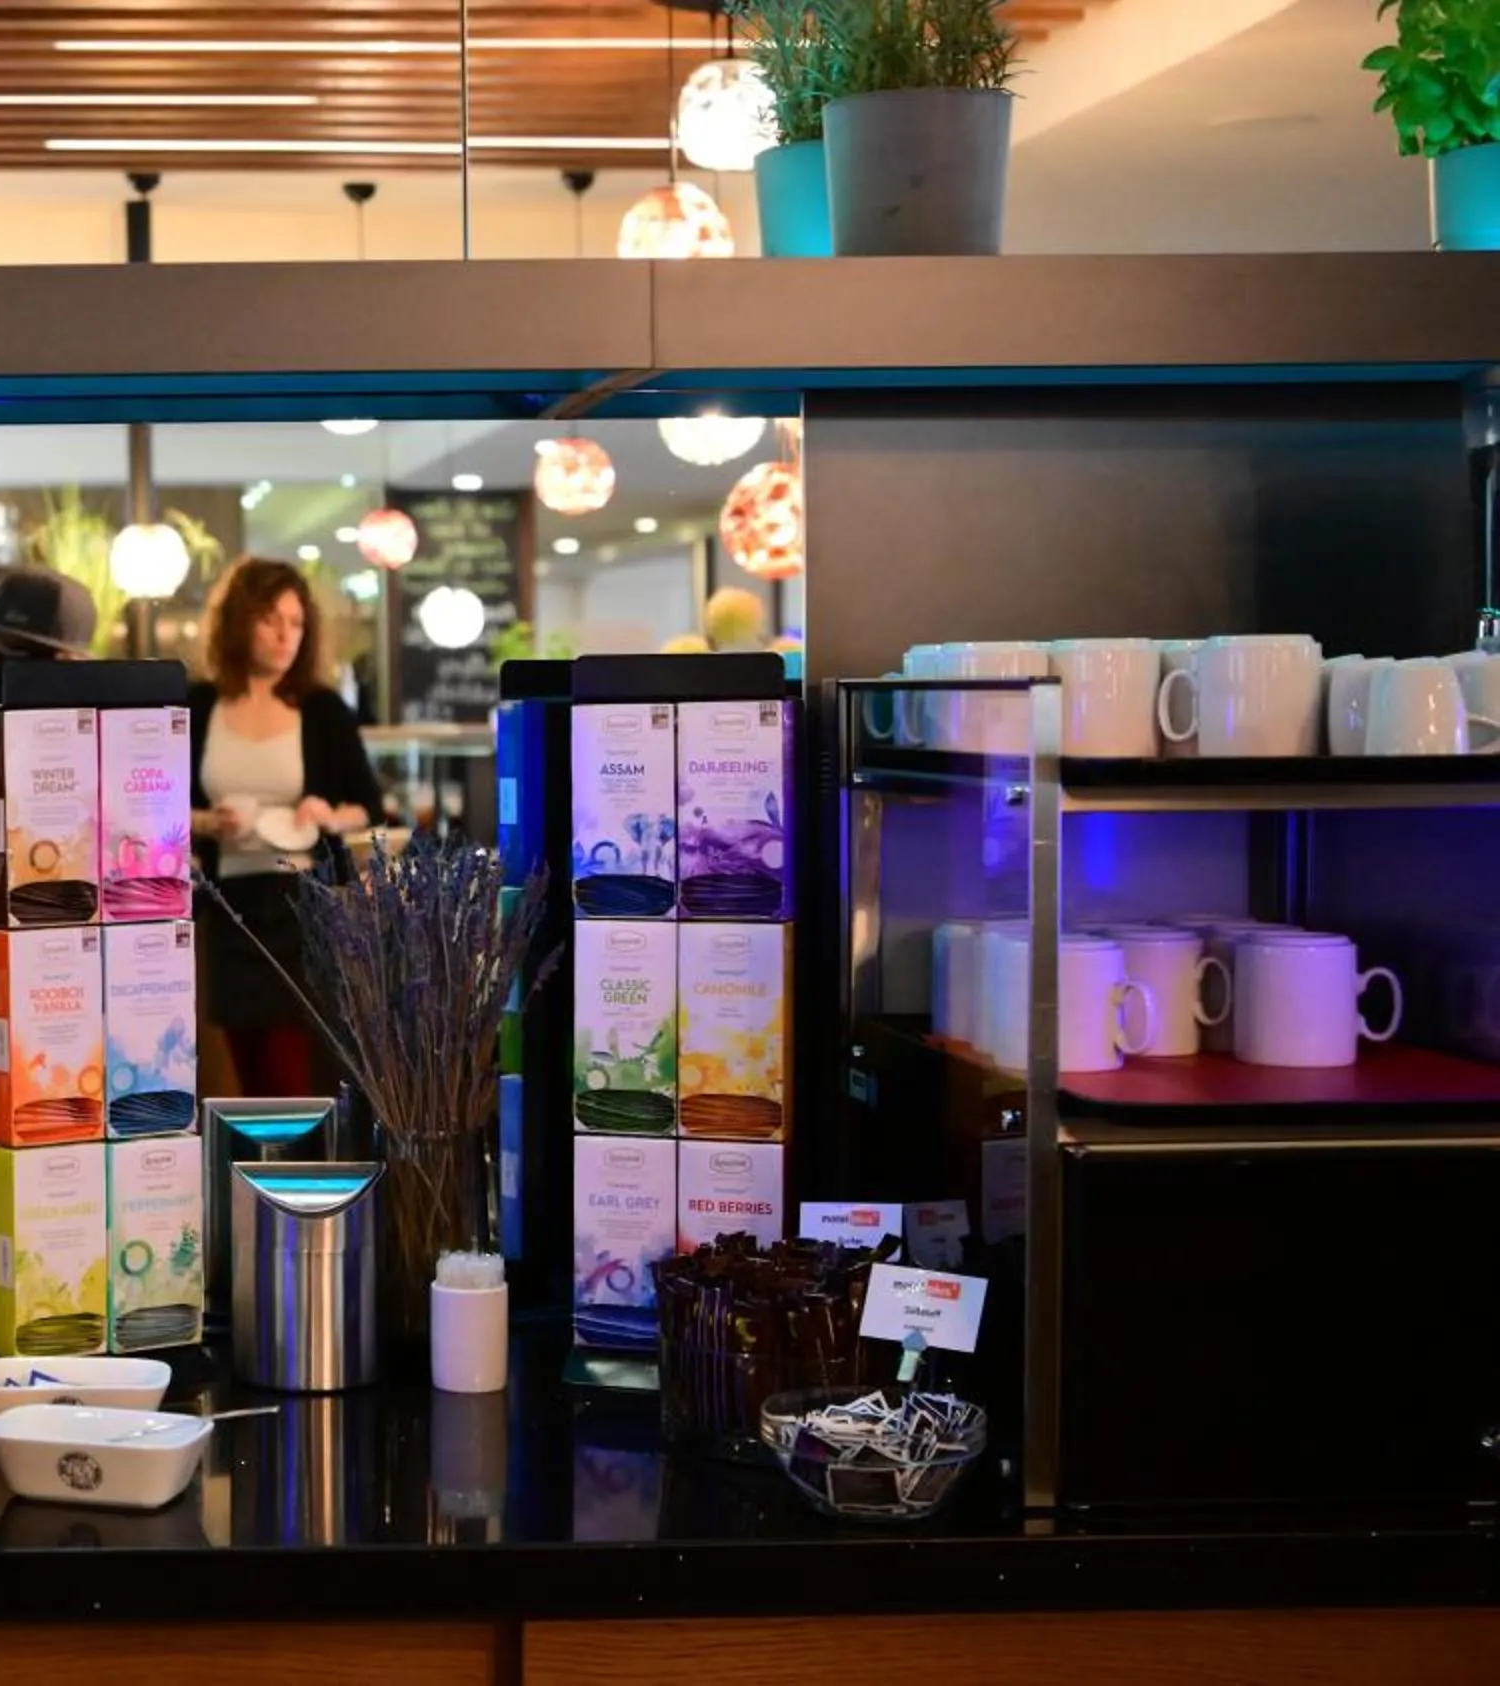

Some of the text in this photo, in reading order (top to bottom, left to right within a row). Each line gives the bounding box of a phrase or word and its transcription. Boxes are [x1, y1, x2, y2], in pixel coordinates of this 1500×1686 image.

[30, 767, 75, 781] WINTER
[131, 767, 165, 781] COPA
[600, 763, 645, 775] ASSAM
[689, 761, 770, 774] DARJEELING
[600, 978, 652, 992] CLASSIC
[603, 991, 648, 1006] GREEN
[588, 1193, 661, 1211] EARL GREY
[688, 1198, 774, 1216] RED BERRIES
